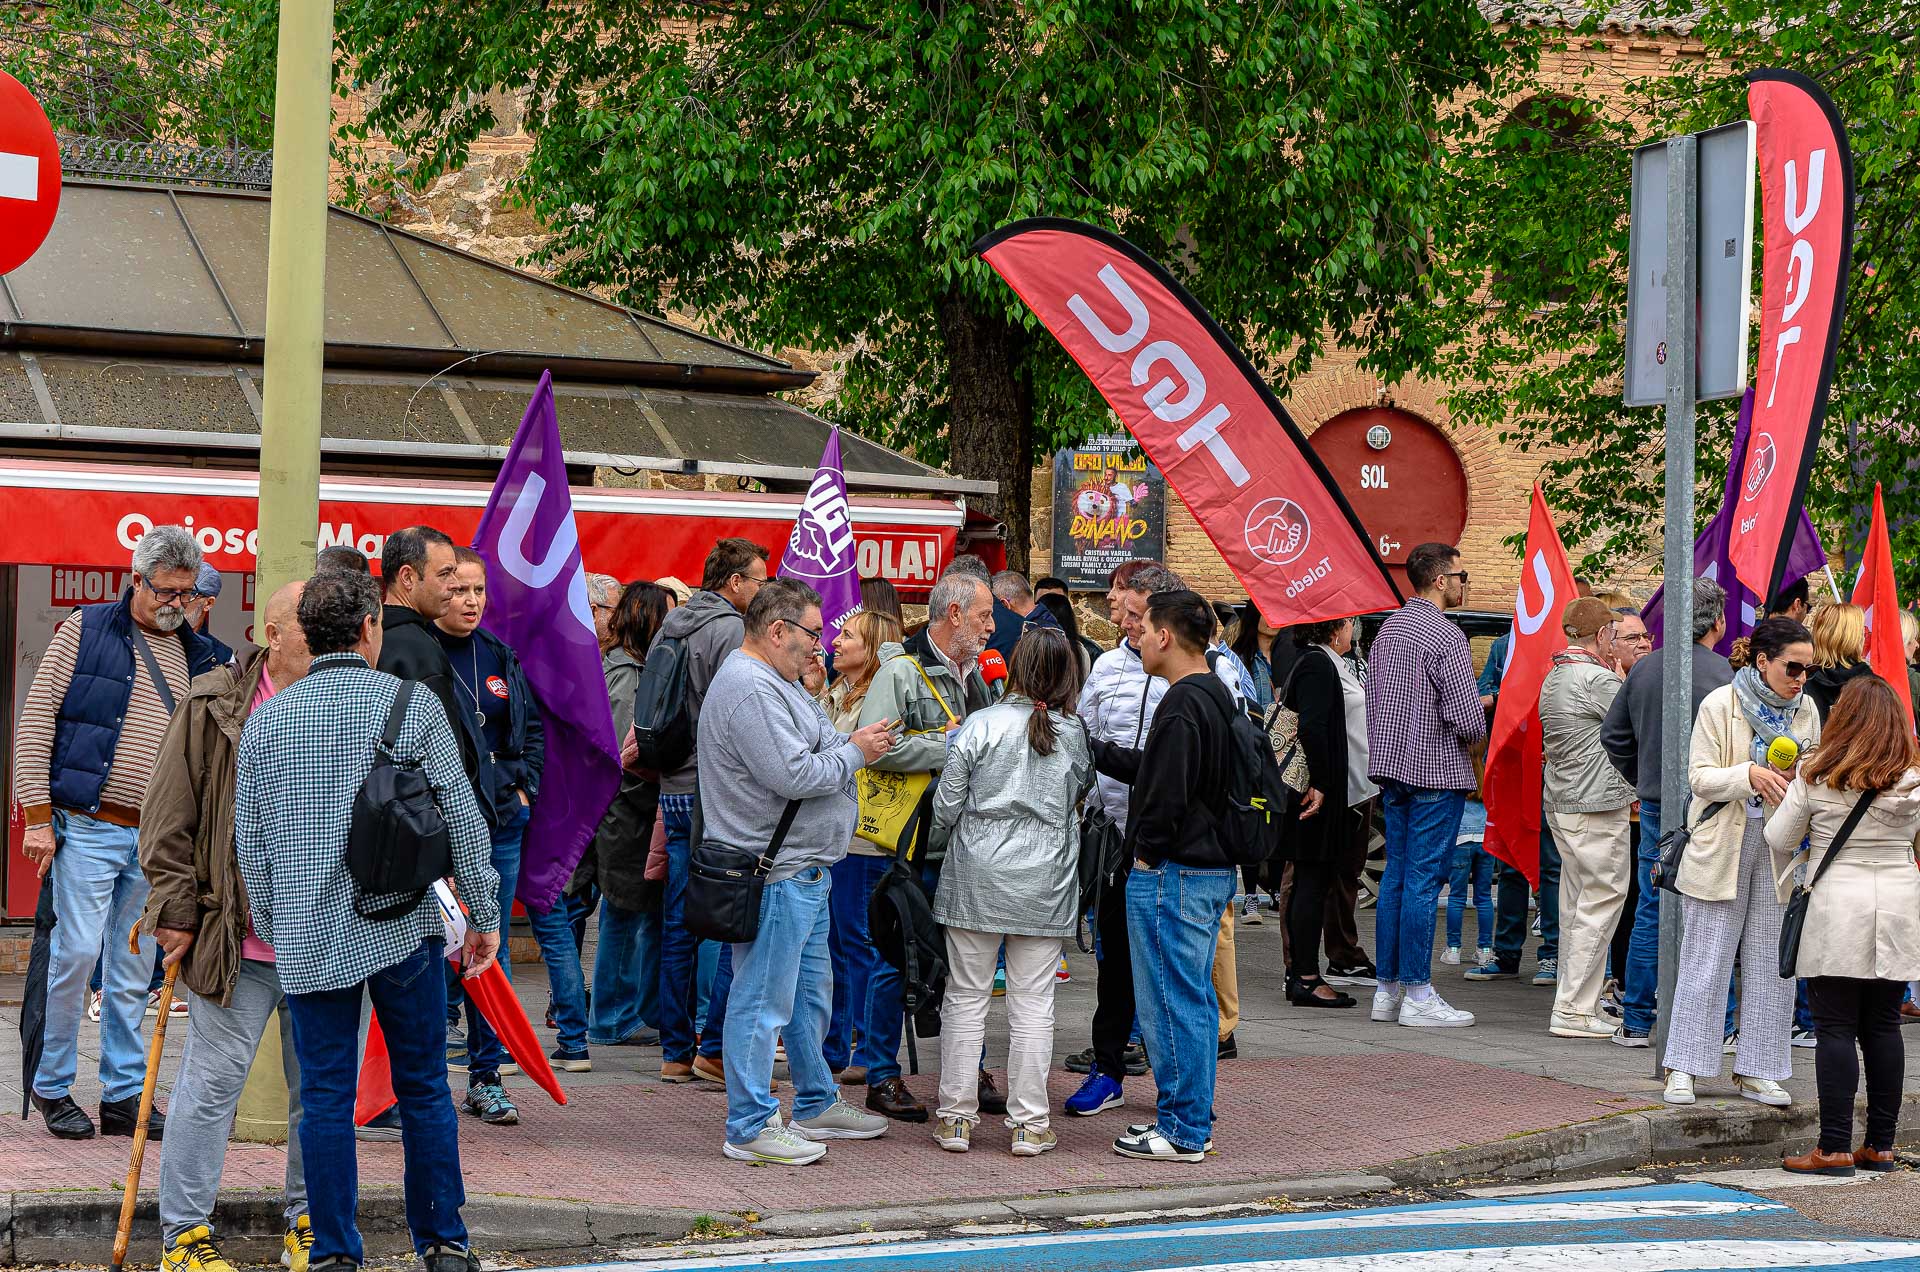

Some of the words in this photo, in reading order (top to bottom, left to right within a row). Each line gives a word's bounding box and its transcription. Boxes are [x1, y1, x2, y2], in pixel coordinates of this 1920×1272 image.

[1361, 464, 1389, 489] SOL
[317, 522, 390, 560] Ma
[1084, 549, 1110, 557] CRISTIAN
[1379, 534, 1391, 557] 6
[854, 539, 936, 581] OLA!
[985, 656, 1003, 666] rne
